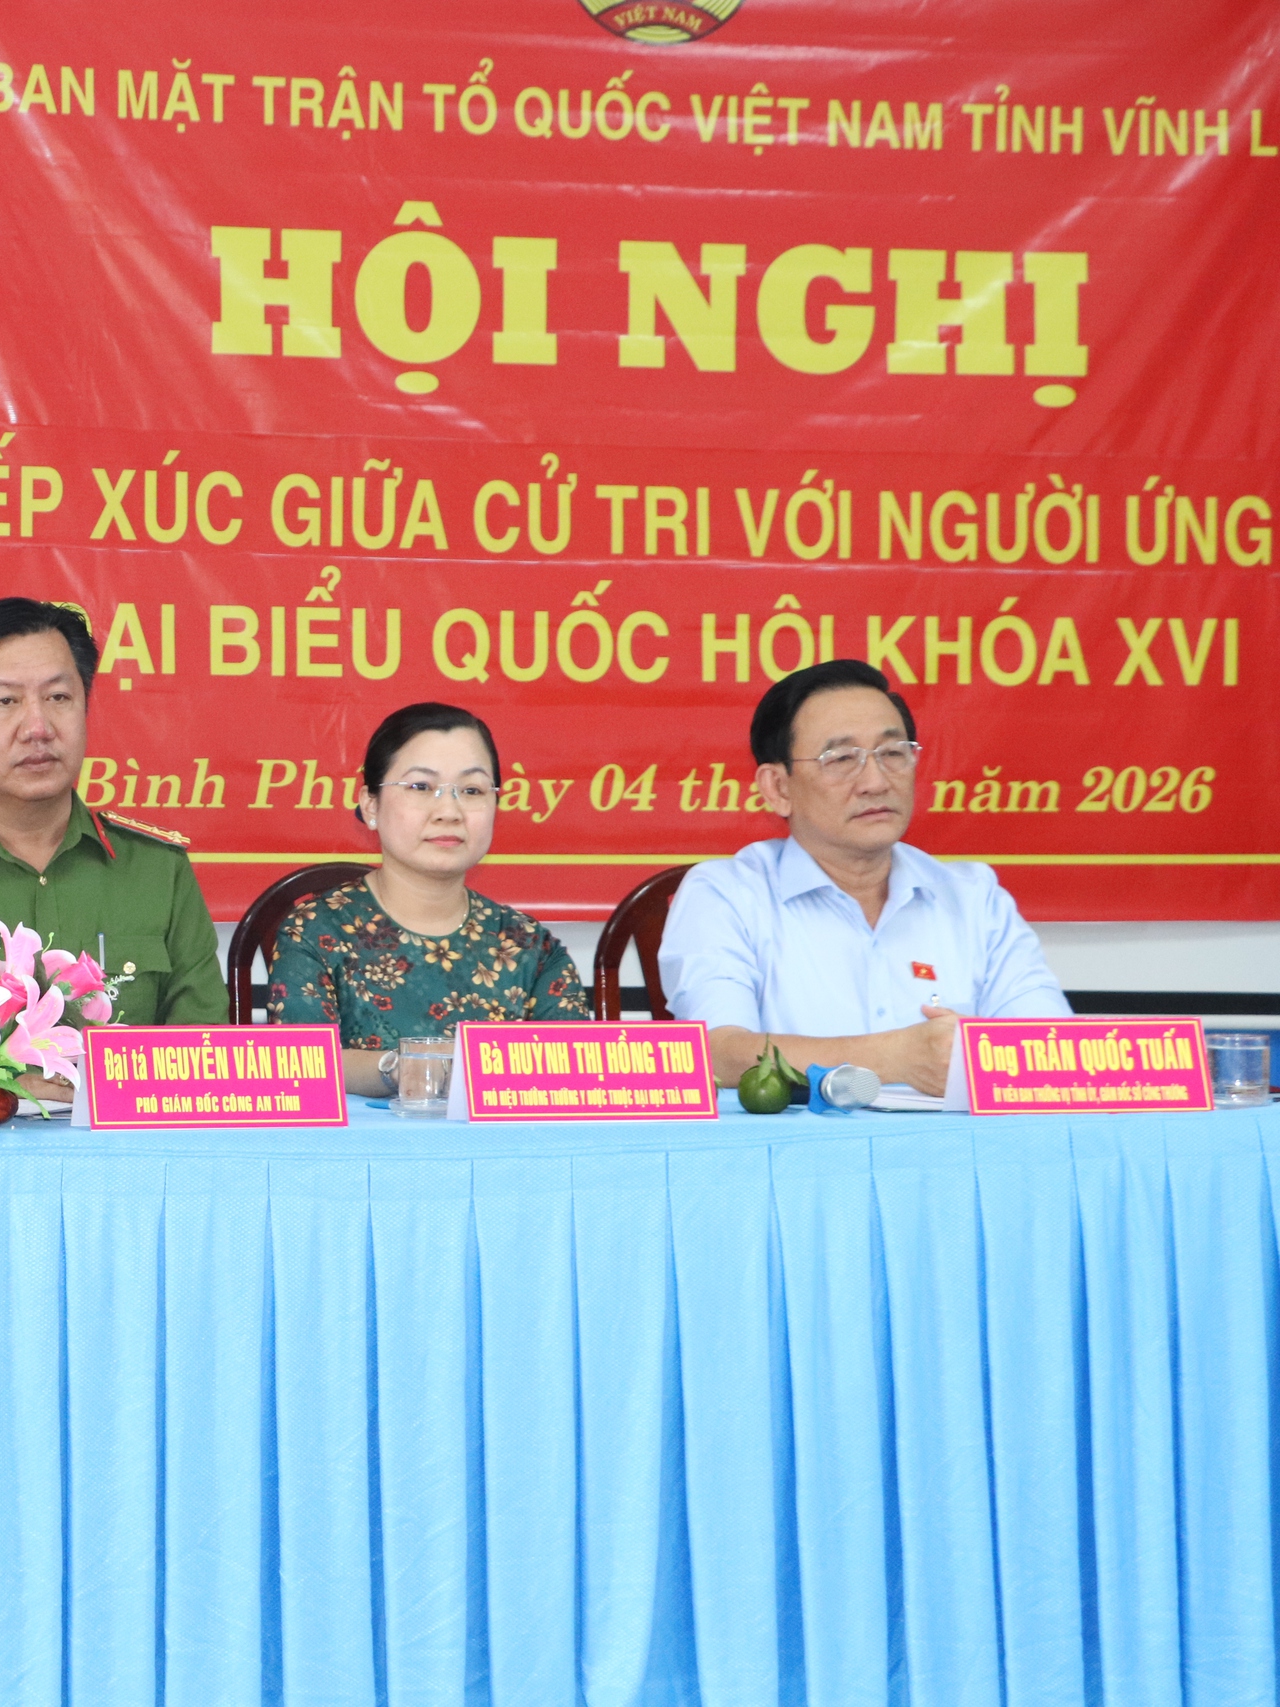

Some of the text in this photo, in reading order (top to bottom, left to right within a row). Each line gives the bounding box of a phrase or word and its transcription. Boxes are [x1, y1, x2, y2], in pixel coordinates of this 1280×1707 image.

[613, 4, 704, 31] VIỆT NAM
[118, 58, 235, 132] MẶT
[252, 66, 403, 140] TRẬN
[423, 58, 497, 135] TỔ
[515, 70, 671, 141] QUỐC
[690, 82, 810, 155] VIỆT
[828, 100, 943, 150] NAM
[962, 84, 1083, 154] TỈNH
[1103, 96, 1229, 155] VĨNH
[210, 201, 1089, 407] HỘI NGHỊ
[90, 450, 243, 545] XÚC
[271, 458, 448, 550] GIỮA
[474, 453, 577, 554] CỬ
[596, 485, 710, 556] TRI
[735, 469, 851, 560] VỚI
[879, 474, 1099, 564] NGƯỜI
[1126, 476, 1271, 566] ỨNG
[52, 602, 176, 691] ẠI
[210, 565, 401, 680] BIỂU
[432, 580, 669, 683] QUỐC
[867, 597, 1090, 686] KHÓA
[1115, 618, 1238, 685] XVI
[76, 757, 225, 808] Bình
[590, 764, 657, 811] 04
[929, 767, 1059, 812] năm
[1076, 766, 1215, 812] 2026
[104, 1031, 326, 1089] Đại tá NGUYỄN VĂN HẠNH
[479, 1030, 694, 1081] Bà HUỲNH THỊ HỒNG THU
[978, 1025, 1195, 1076] Ông TRẦN QUỐC TUẤN
[136, 1092, 300, 1113] PHÓ GIÁM ĐỐC CÔNG AN TỈNH
